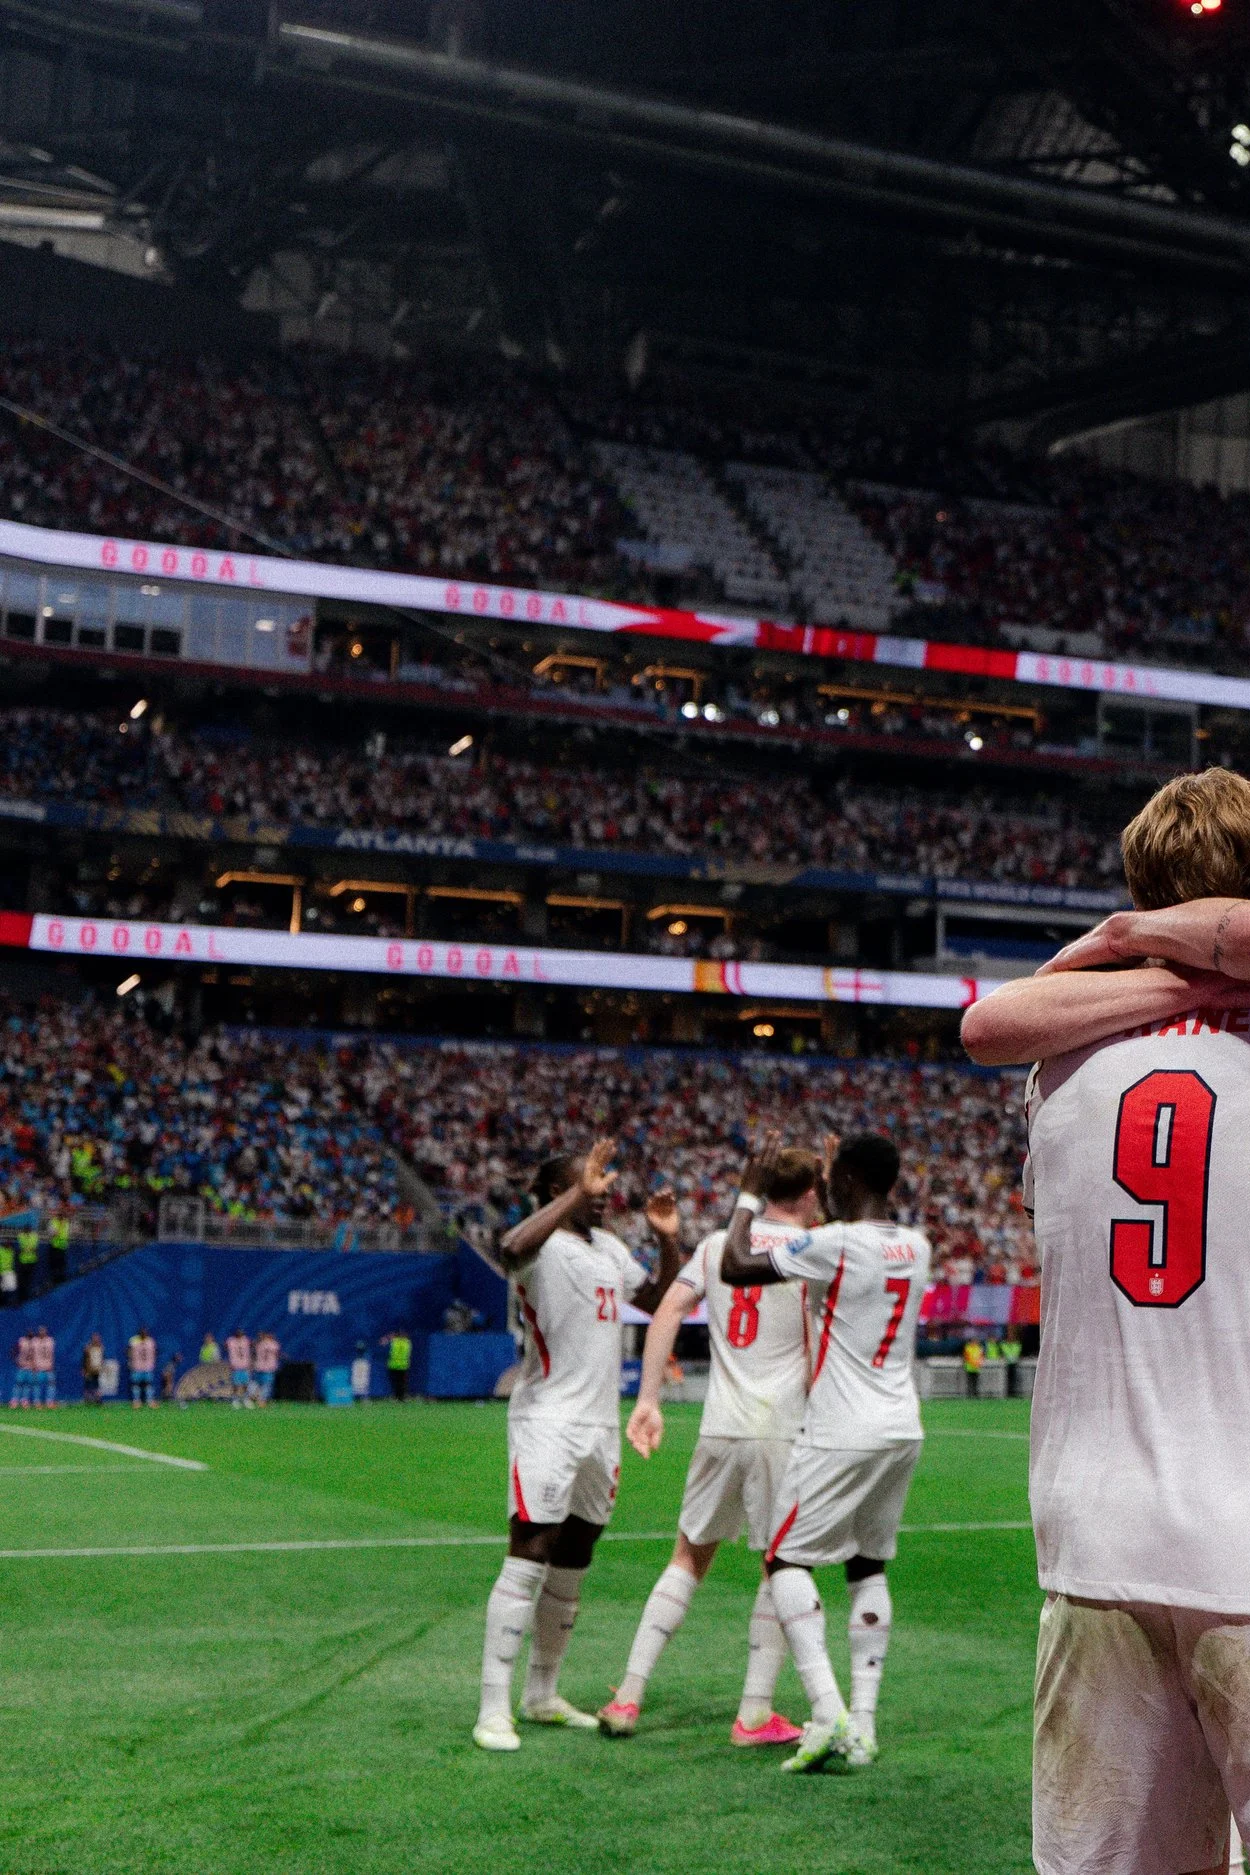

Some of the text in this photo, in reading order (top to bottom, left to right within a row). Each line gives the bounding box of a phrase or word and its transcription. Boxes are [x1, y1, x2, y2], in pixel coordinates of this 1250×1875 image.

[334, 829, 477, 858] ATLANTA
[48, 917, 225, 961] GOOOAL
[1109, 1068, 1218, 1309] 9
[287, 1289, 340, 1316] FIFA
[594, 1286, 617, 1323] 21
[727, 1284, 762, 1348] 8
[871, 1277, 911, 1369] 7
